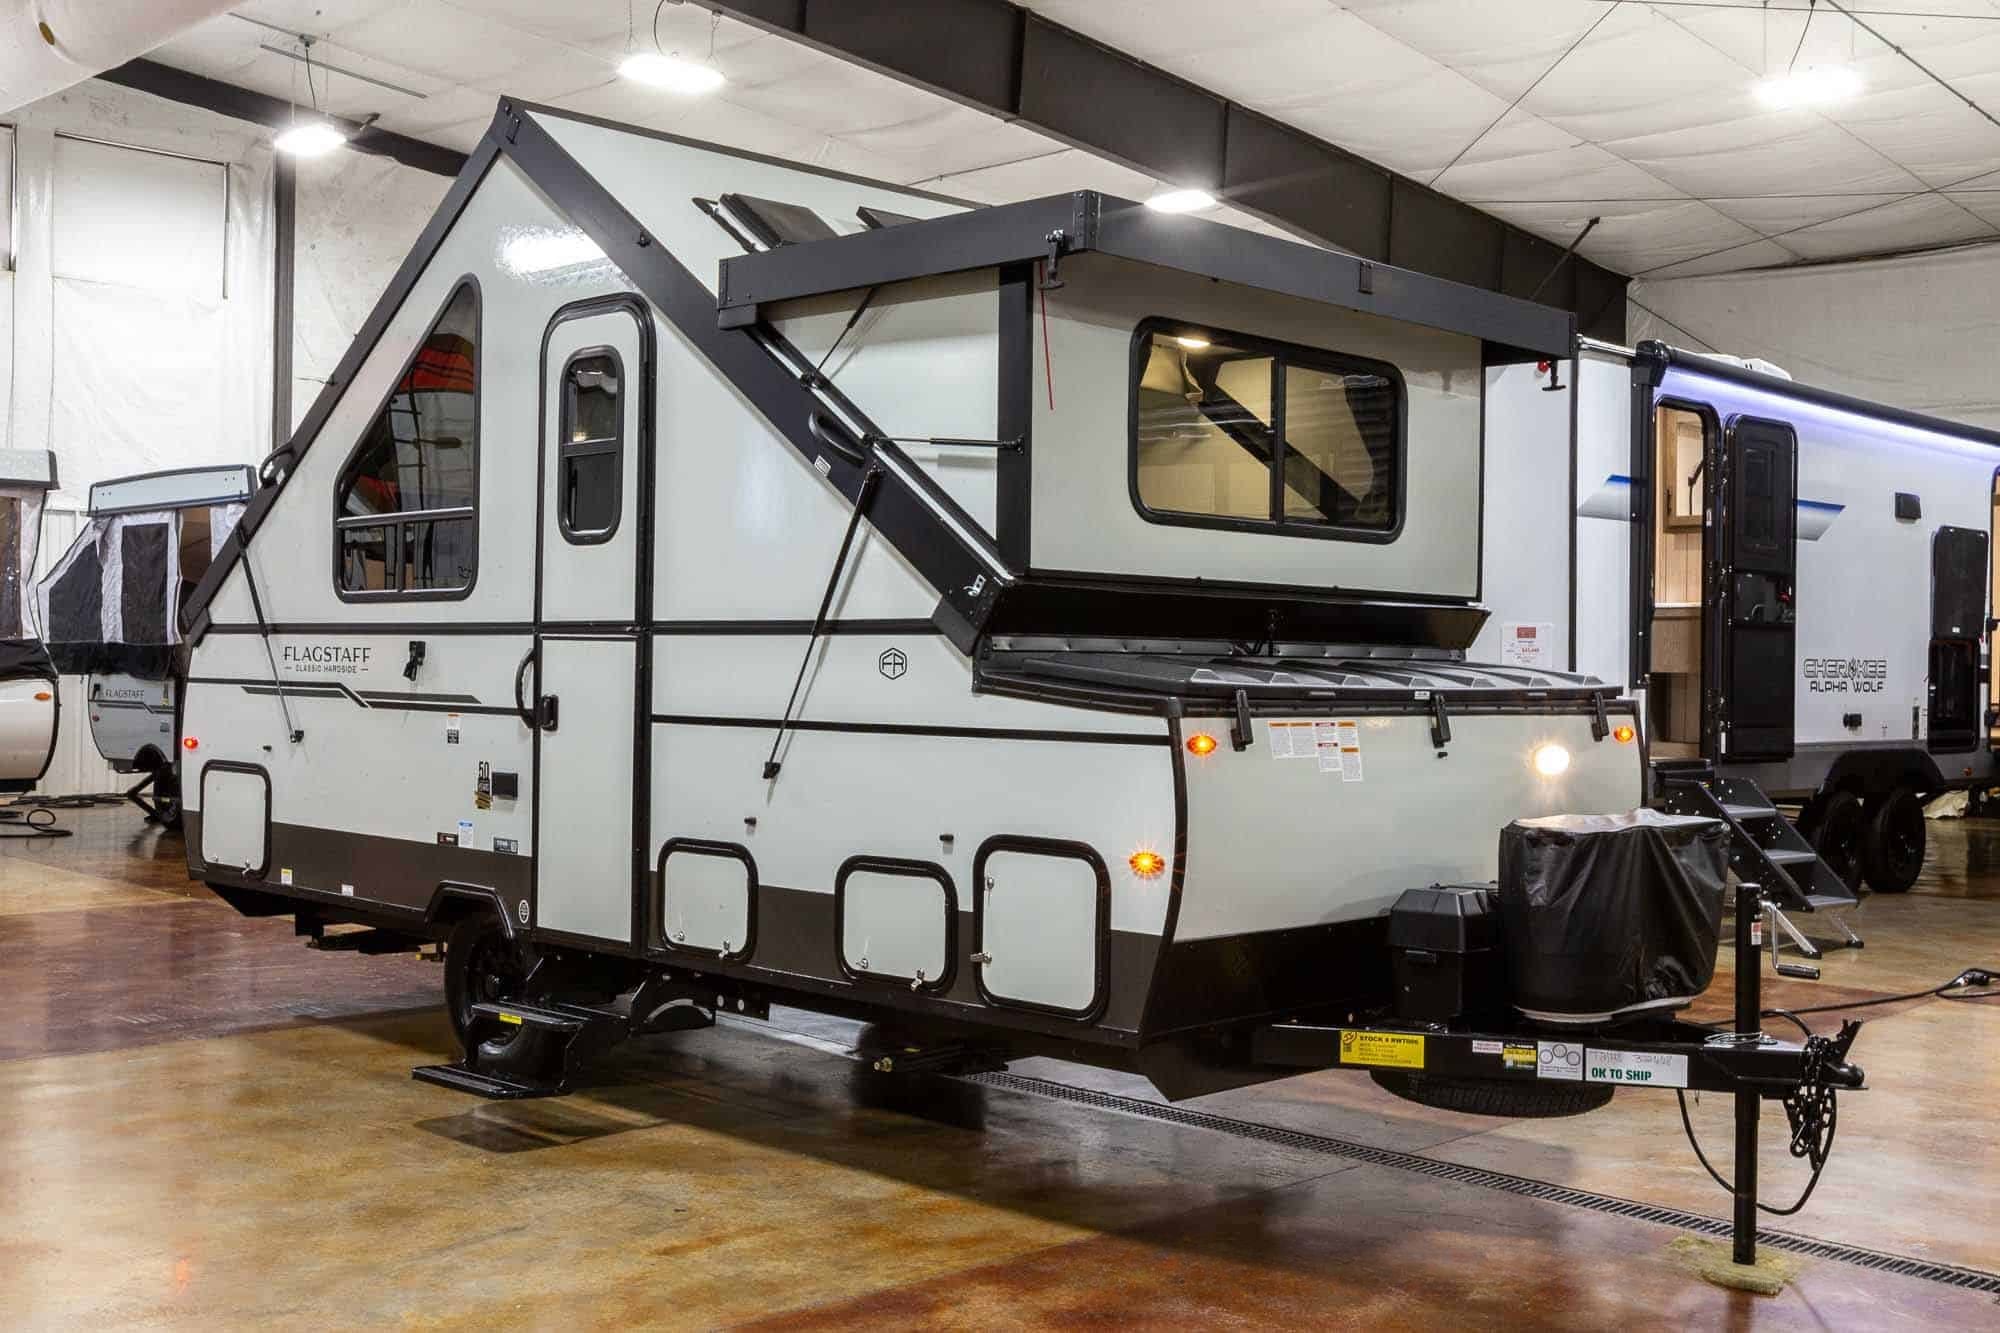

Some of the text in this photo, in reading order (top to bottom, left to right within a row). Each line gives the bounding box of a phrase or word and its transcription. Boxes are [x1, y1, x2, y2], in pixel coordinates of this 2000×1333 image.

[283, 646, 372, 663] FLAGSTAFF
[106, 689, 145, 697] FLAGSTAFF
[1810, 681, 1884, 693] ALPHA WOLF
[478, 760, 490, 779] 50
[1591, 1067, 1607, 1079] OK
[1609, 1068, 1623, 1080] TO
[1625, 1070, 1652, 1081] SHIP
